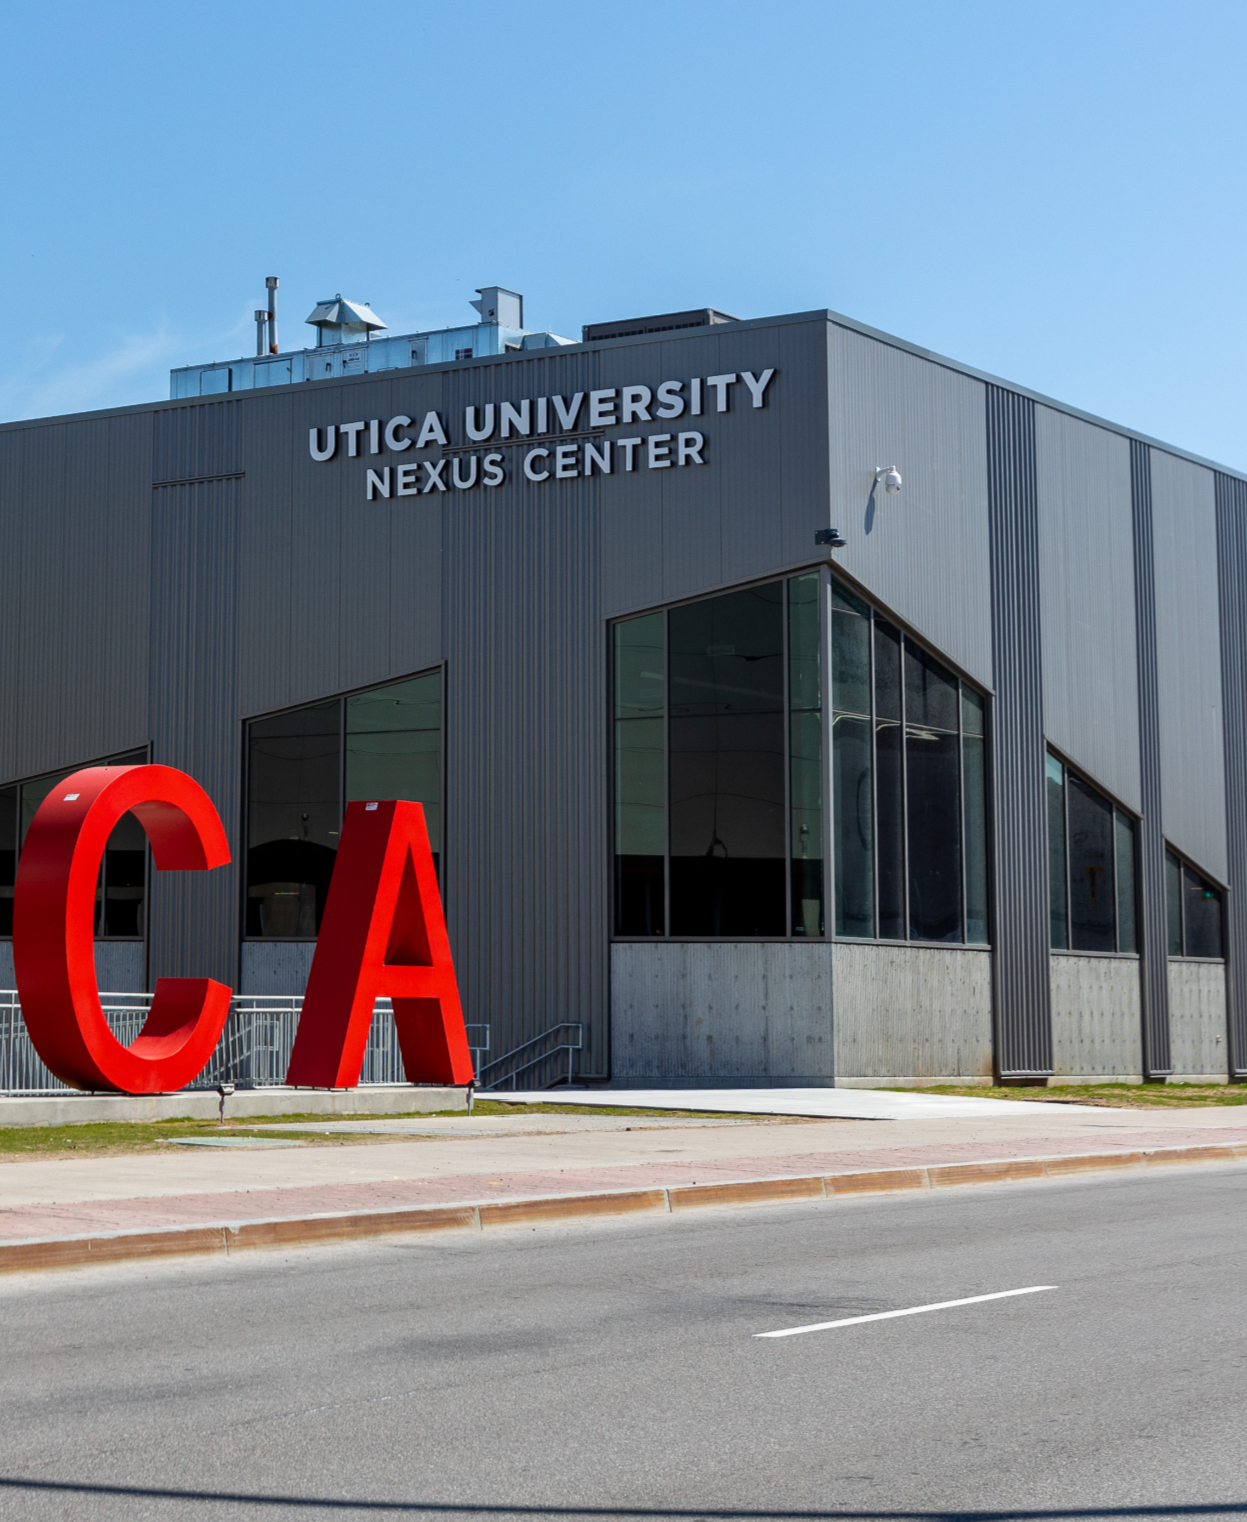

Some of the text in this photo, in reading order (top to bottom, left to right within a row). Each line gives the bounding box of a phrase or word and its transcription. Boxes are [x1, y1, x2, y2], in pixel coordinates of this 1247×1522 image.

[308, 368, 775, 462] UTICA UNIVERSITY
[366, 431, 705, 500] NEXUS CENTER
